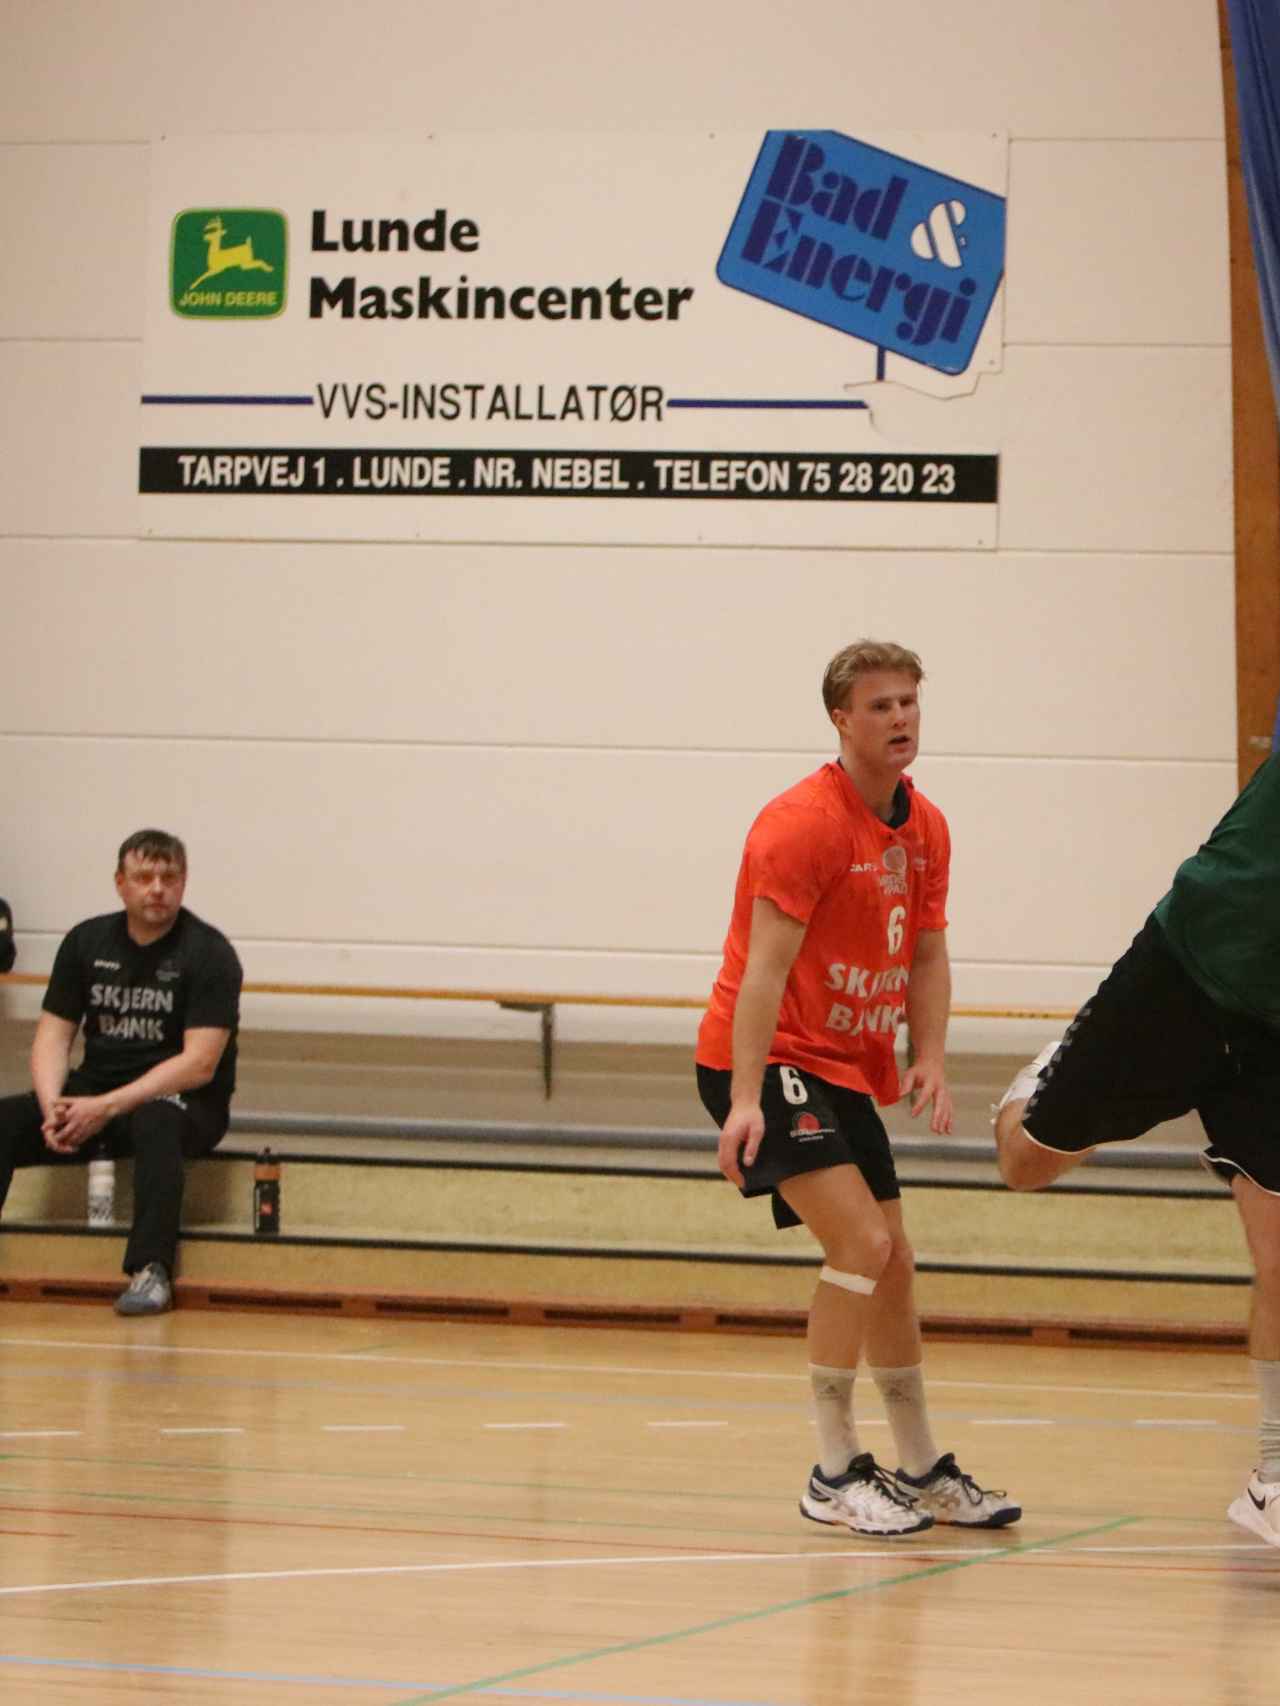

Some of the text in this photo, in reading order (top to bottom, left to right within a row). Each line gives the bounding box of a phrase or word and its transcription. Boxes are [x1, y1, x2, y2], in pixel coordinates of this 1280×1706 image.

[765, 134, 968, 269] Bad &
[311, 208, 481, 253] Lunde
[740, 199, 978, 346] Energi
[180, 290, 277, 308] JOHN DEERE
[308, 274, 695, 320] Maskincenter
[317, 382, 665, 423] VVS-INSTALLATØR
[178, 455, 305, 488] TARPVEJ
[352, 456, 451, 488] LUNDE
[473, 457, 523, 488] NR.
[531, 458, 630, 490] NEBEL
[653, 459, 790, 492] TELEFON
[799, 461, 831, 493] 75
[838, 461, 873, 493] 28
[880, 462, 914, 494] 20
[922, 463, 956, 495] 23
[886, 905, 907, 956] 6
[91, 983, 174, 1014] SKJERN
[98, 1014, 165, 1042] BANK
[779, 1064, 809, 1105] 6
